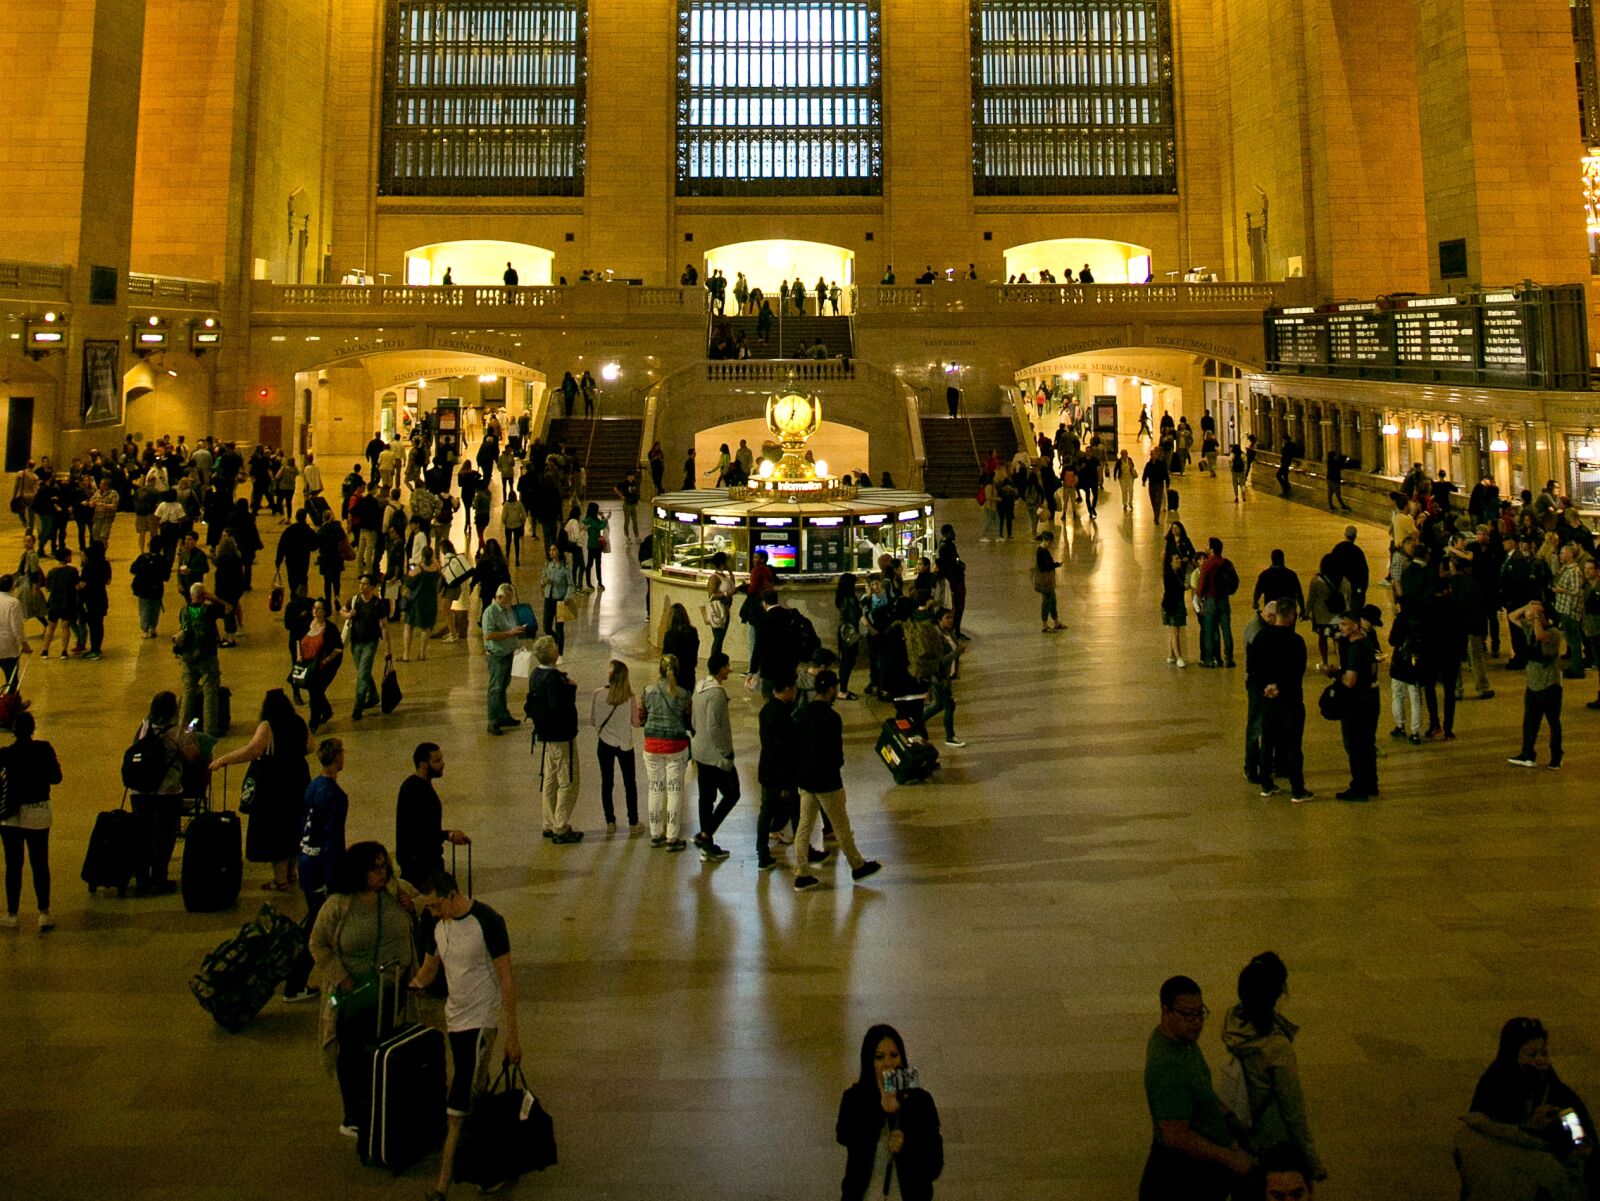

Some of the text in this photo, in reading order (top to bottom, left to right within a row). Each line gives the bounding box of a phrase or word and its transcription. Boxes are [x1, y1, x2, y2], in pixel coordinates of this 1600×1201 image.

[333, 343, 369, 356] TRACKS
[438, 339, 493, 354] LEXINGTON
[1047, 337, 1121, 356] LEXINGTON AVE
[1155, 336, 1237, 357] TICKET MACHINES
[414, 368, 442, 378] STREET
[484, 366, 514, 375] SUBWAY
[1054, 363, 1087, 371] PASSAGE
[1091, 363, 1124, 372] SUBWAY
[777, 481, 822, 491] Information
